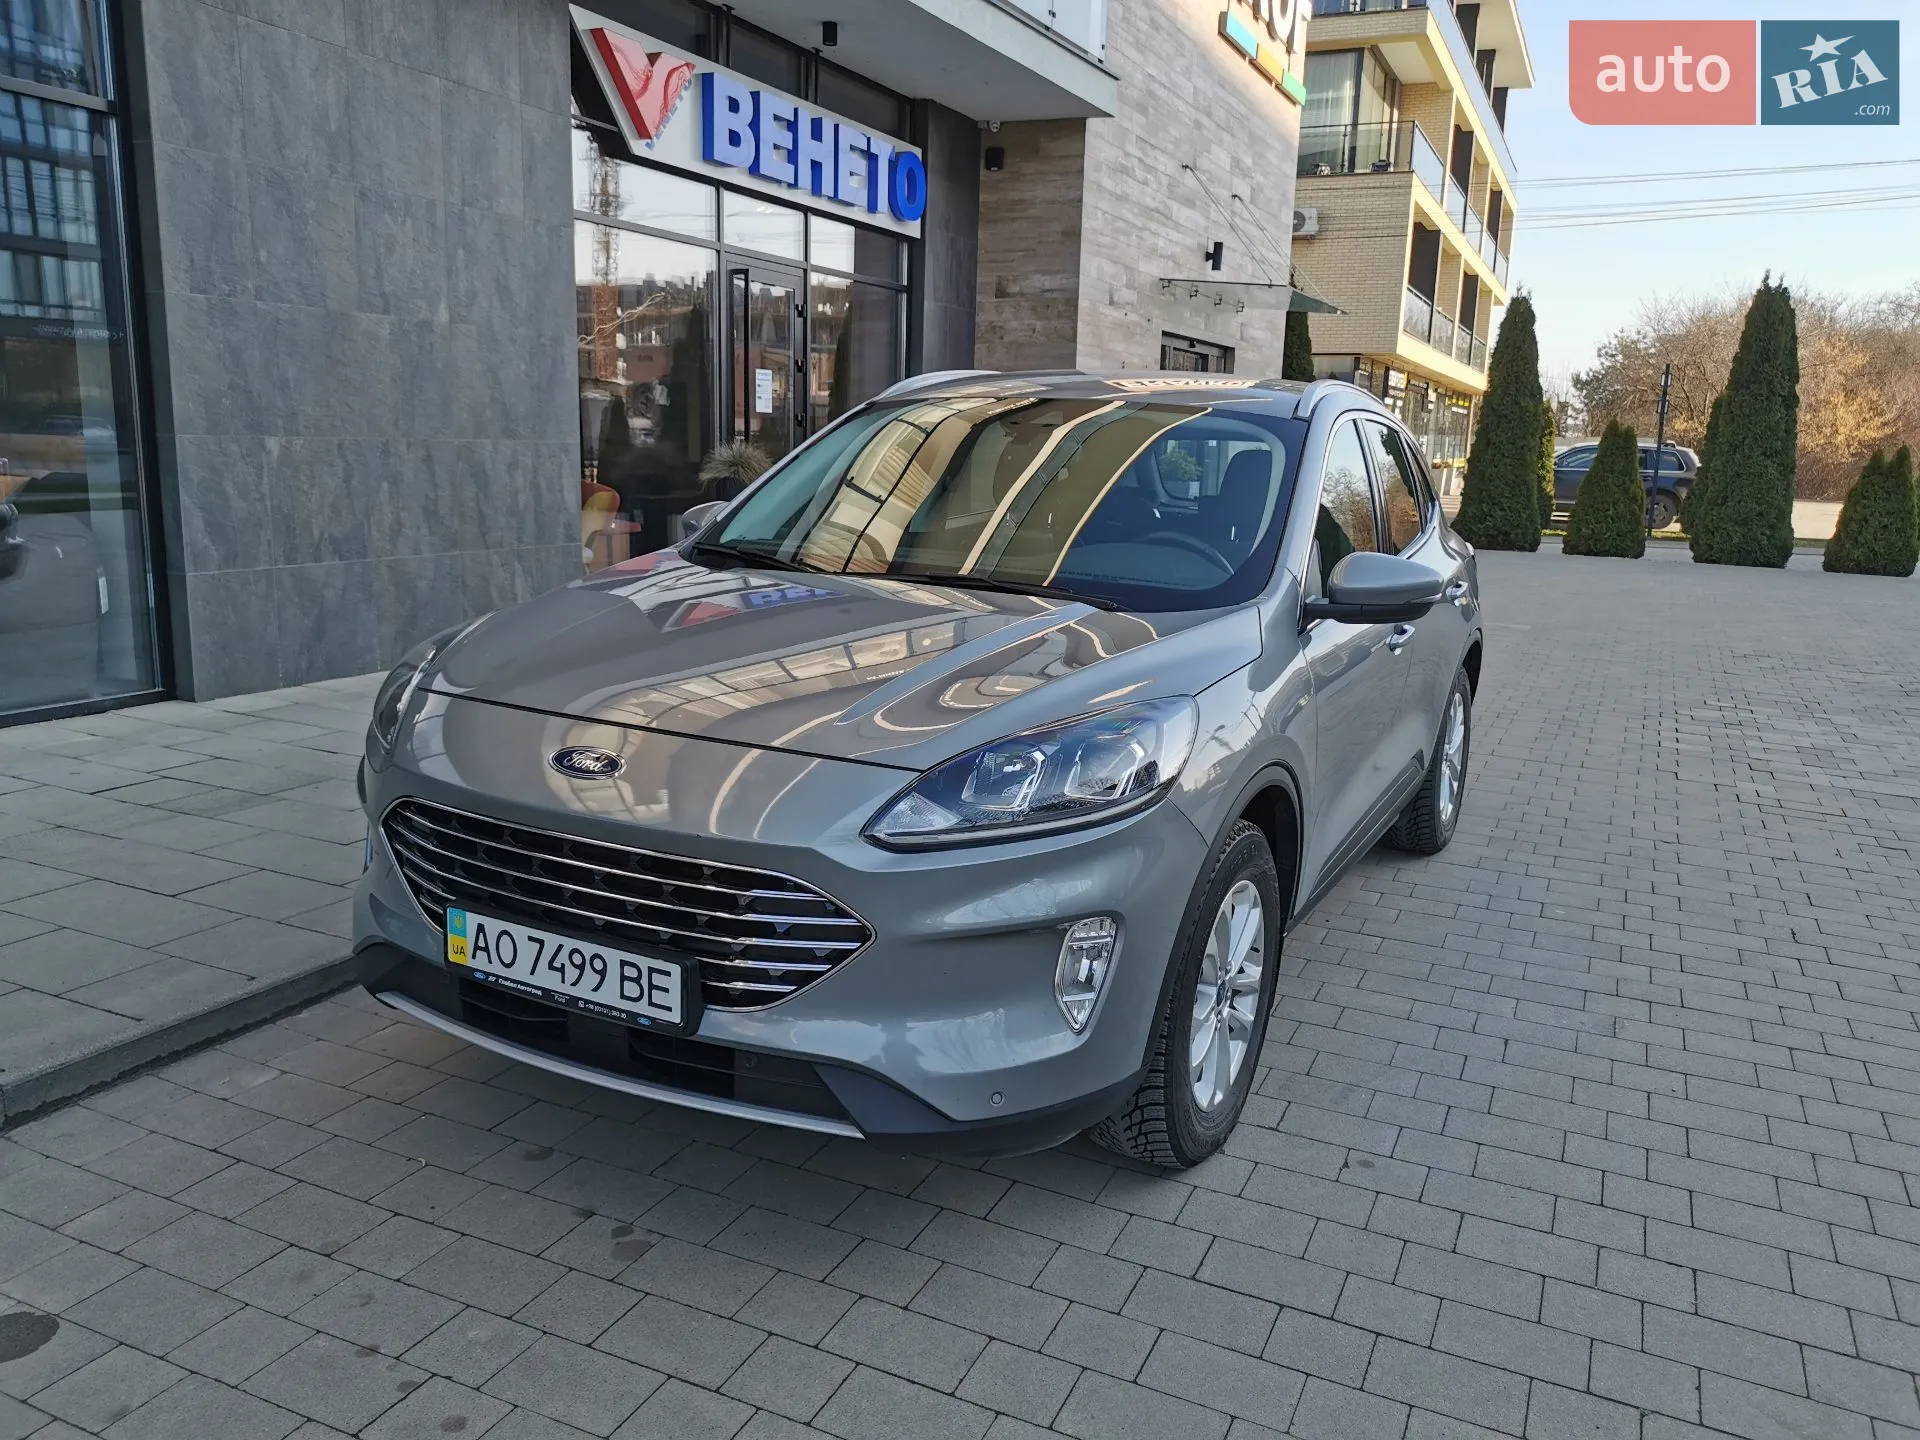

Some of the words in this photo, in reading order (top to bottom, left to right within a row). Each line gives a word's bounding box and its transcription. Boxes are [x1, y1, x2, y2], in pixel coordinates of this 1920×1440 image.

[701, 72, 927, 223] ВЕНЕТО
[563, 750, 611, 772] Ford
[452, 943, 466, 957] UA
[471, 922, 518, 969] AO
[527, 935, 608, 993] 7499
[619, 958, 673, 1013] BE
